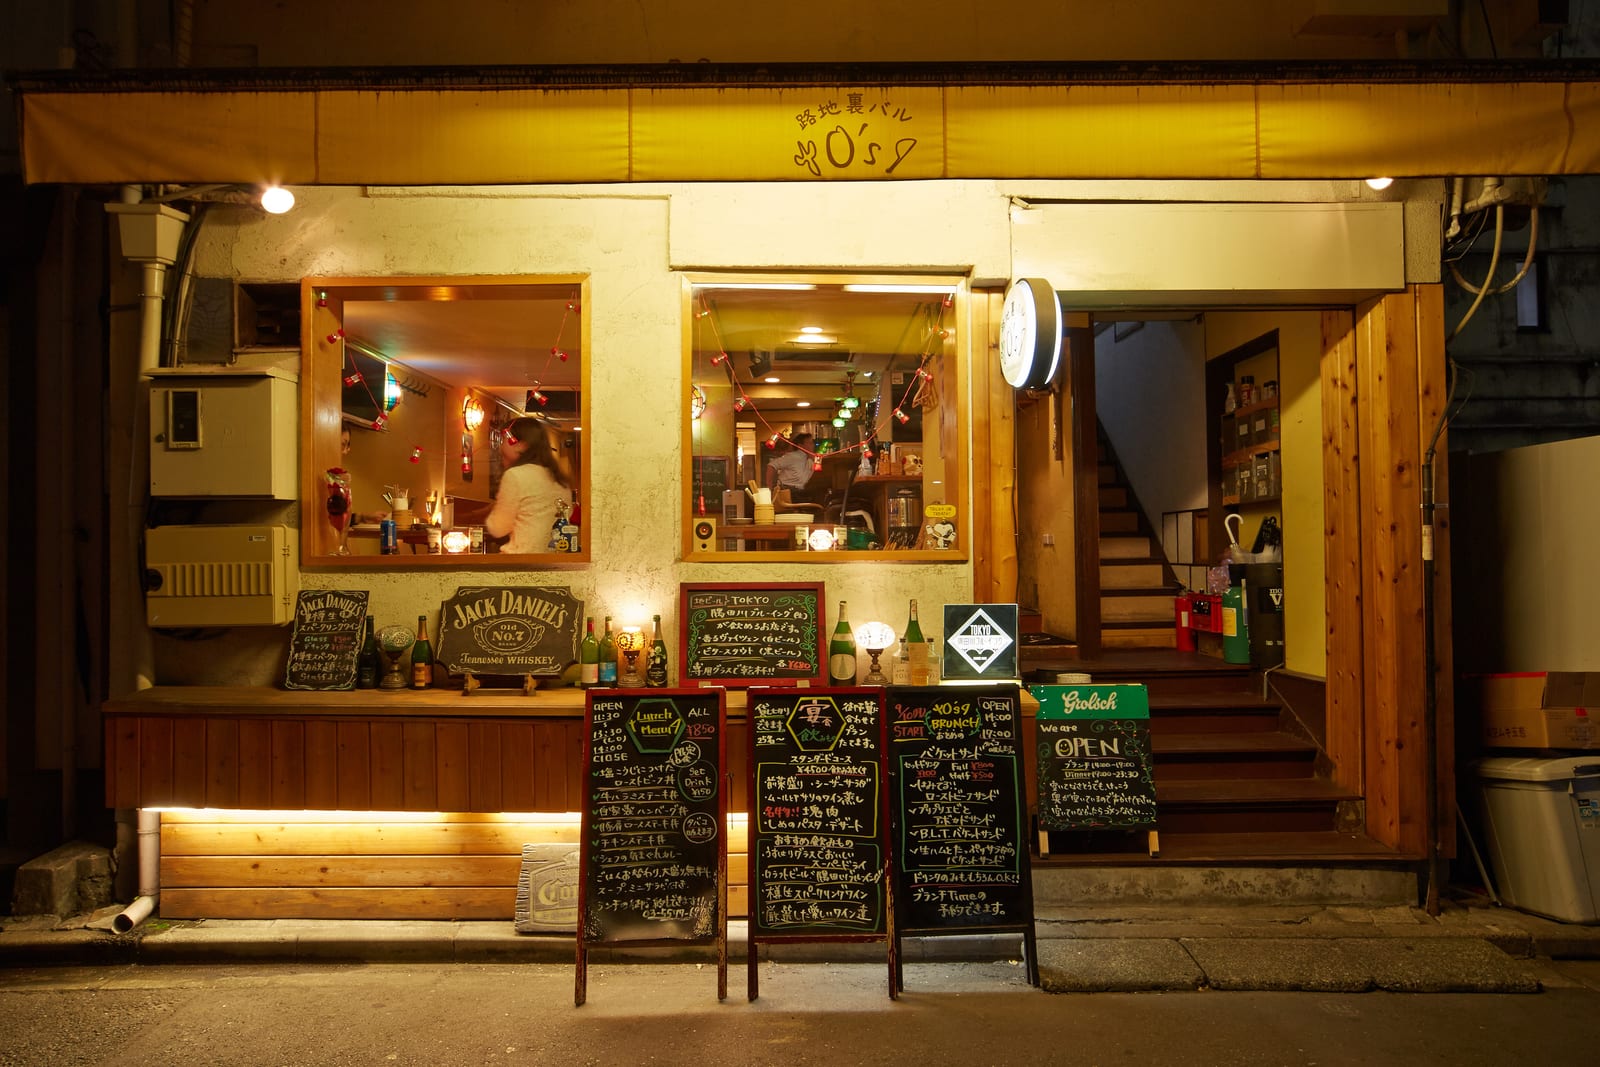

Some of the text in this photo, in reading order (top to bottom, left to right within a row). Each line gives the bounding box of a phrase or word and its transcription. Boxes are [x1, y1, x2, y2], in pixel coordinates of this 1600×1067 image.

[795, 92, 912, 130] 路地裏バル
[300, 598, 325, 616] JACK
[454, 590, 568, 629] JACK DANIEL'S
[970, 625, 991, 636] TOKYO
[460, 652, 555, 665] Tennessee WHISKEY
[593, 702, 623, 711] OPEN
[982, 701, 1010, 711] OPEN
[1061, 690, 1117, 715] Grolsch
[594, 712, 620, 721] 11:30
[636, 708, 673, 720] Lunch
[688, 708, 710, 718] ALL
[984, 712, 1012, 722] 14:00
[931, 717, 980, 730] BRUNCH
[1040, 724, 1058, 733] We
[593, 728, 622, 739] 13:30
[641, 725, 672, 734] Menu
[845, 724, 867, 736] プラン
[894, 725, 925, 737] START
[982, 729, 1011, 739] 17:00
[593, 744, 623, 754] 14:00
[920, 745, 985, 760] バケットサンド
[1055, 737, 1120, 757] OPEN
[790, 753, 852, 763] スタンダードコース
[1064, 760, 1090, 769] ブランチ
[689, 767, 706, 776] Set
[684, 776, 712, 787] Drink
[687, 817, 708, 827] タバコ
